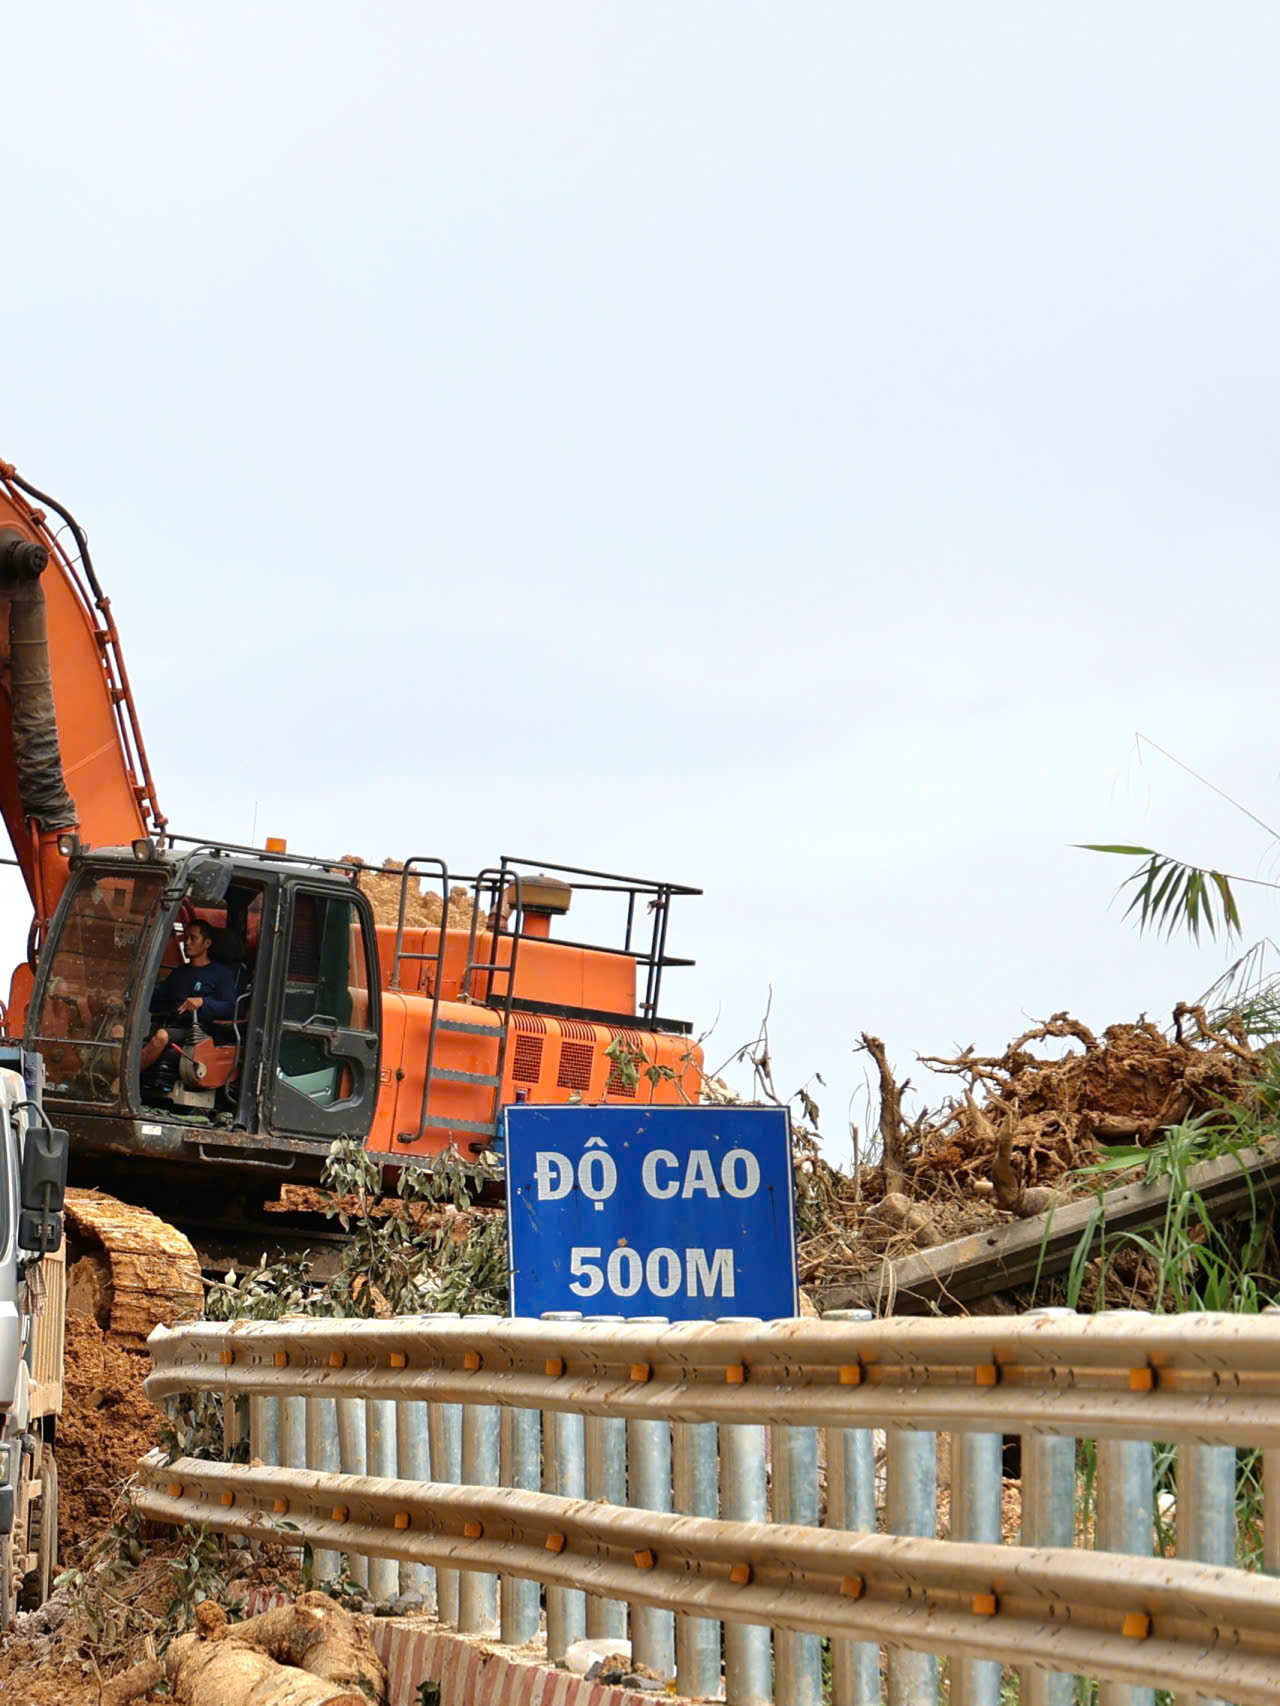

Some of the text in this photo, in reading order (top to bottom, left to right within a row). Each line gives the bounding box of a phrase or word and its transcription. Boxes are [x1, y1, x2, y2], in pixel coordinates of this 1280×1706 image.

[534, 1137, 761, 1210] ĐỘ CAO
[569, 1248, 735, 1297] 500M
